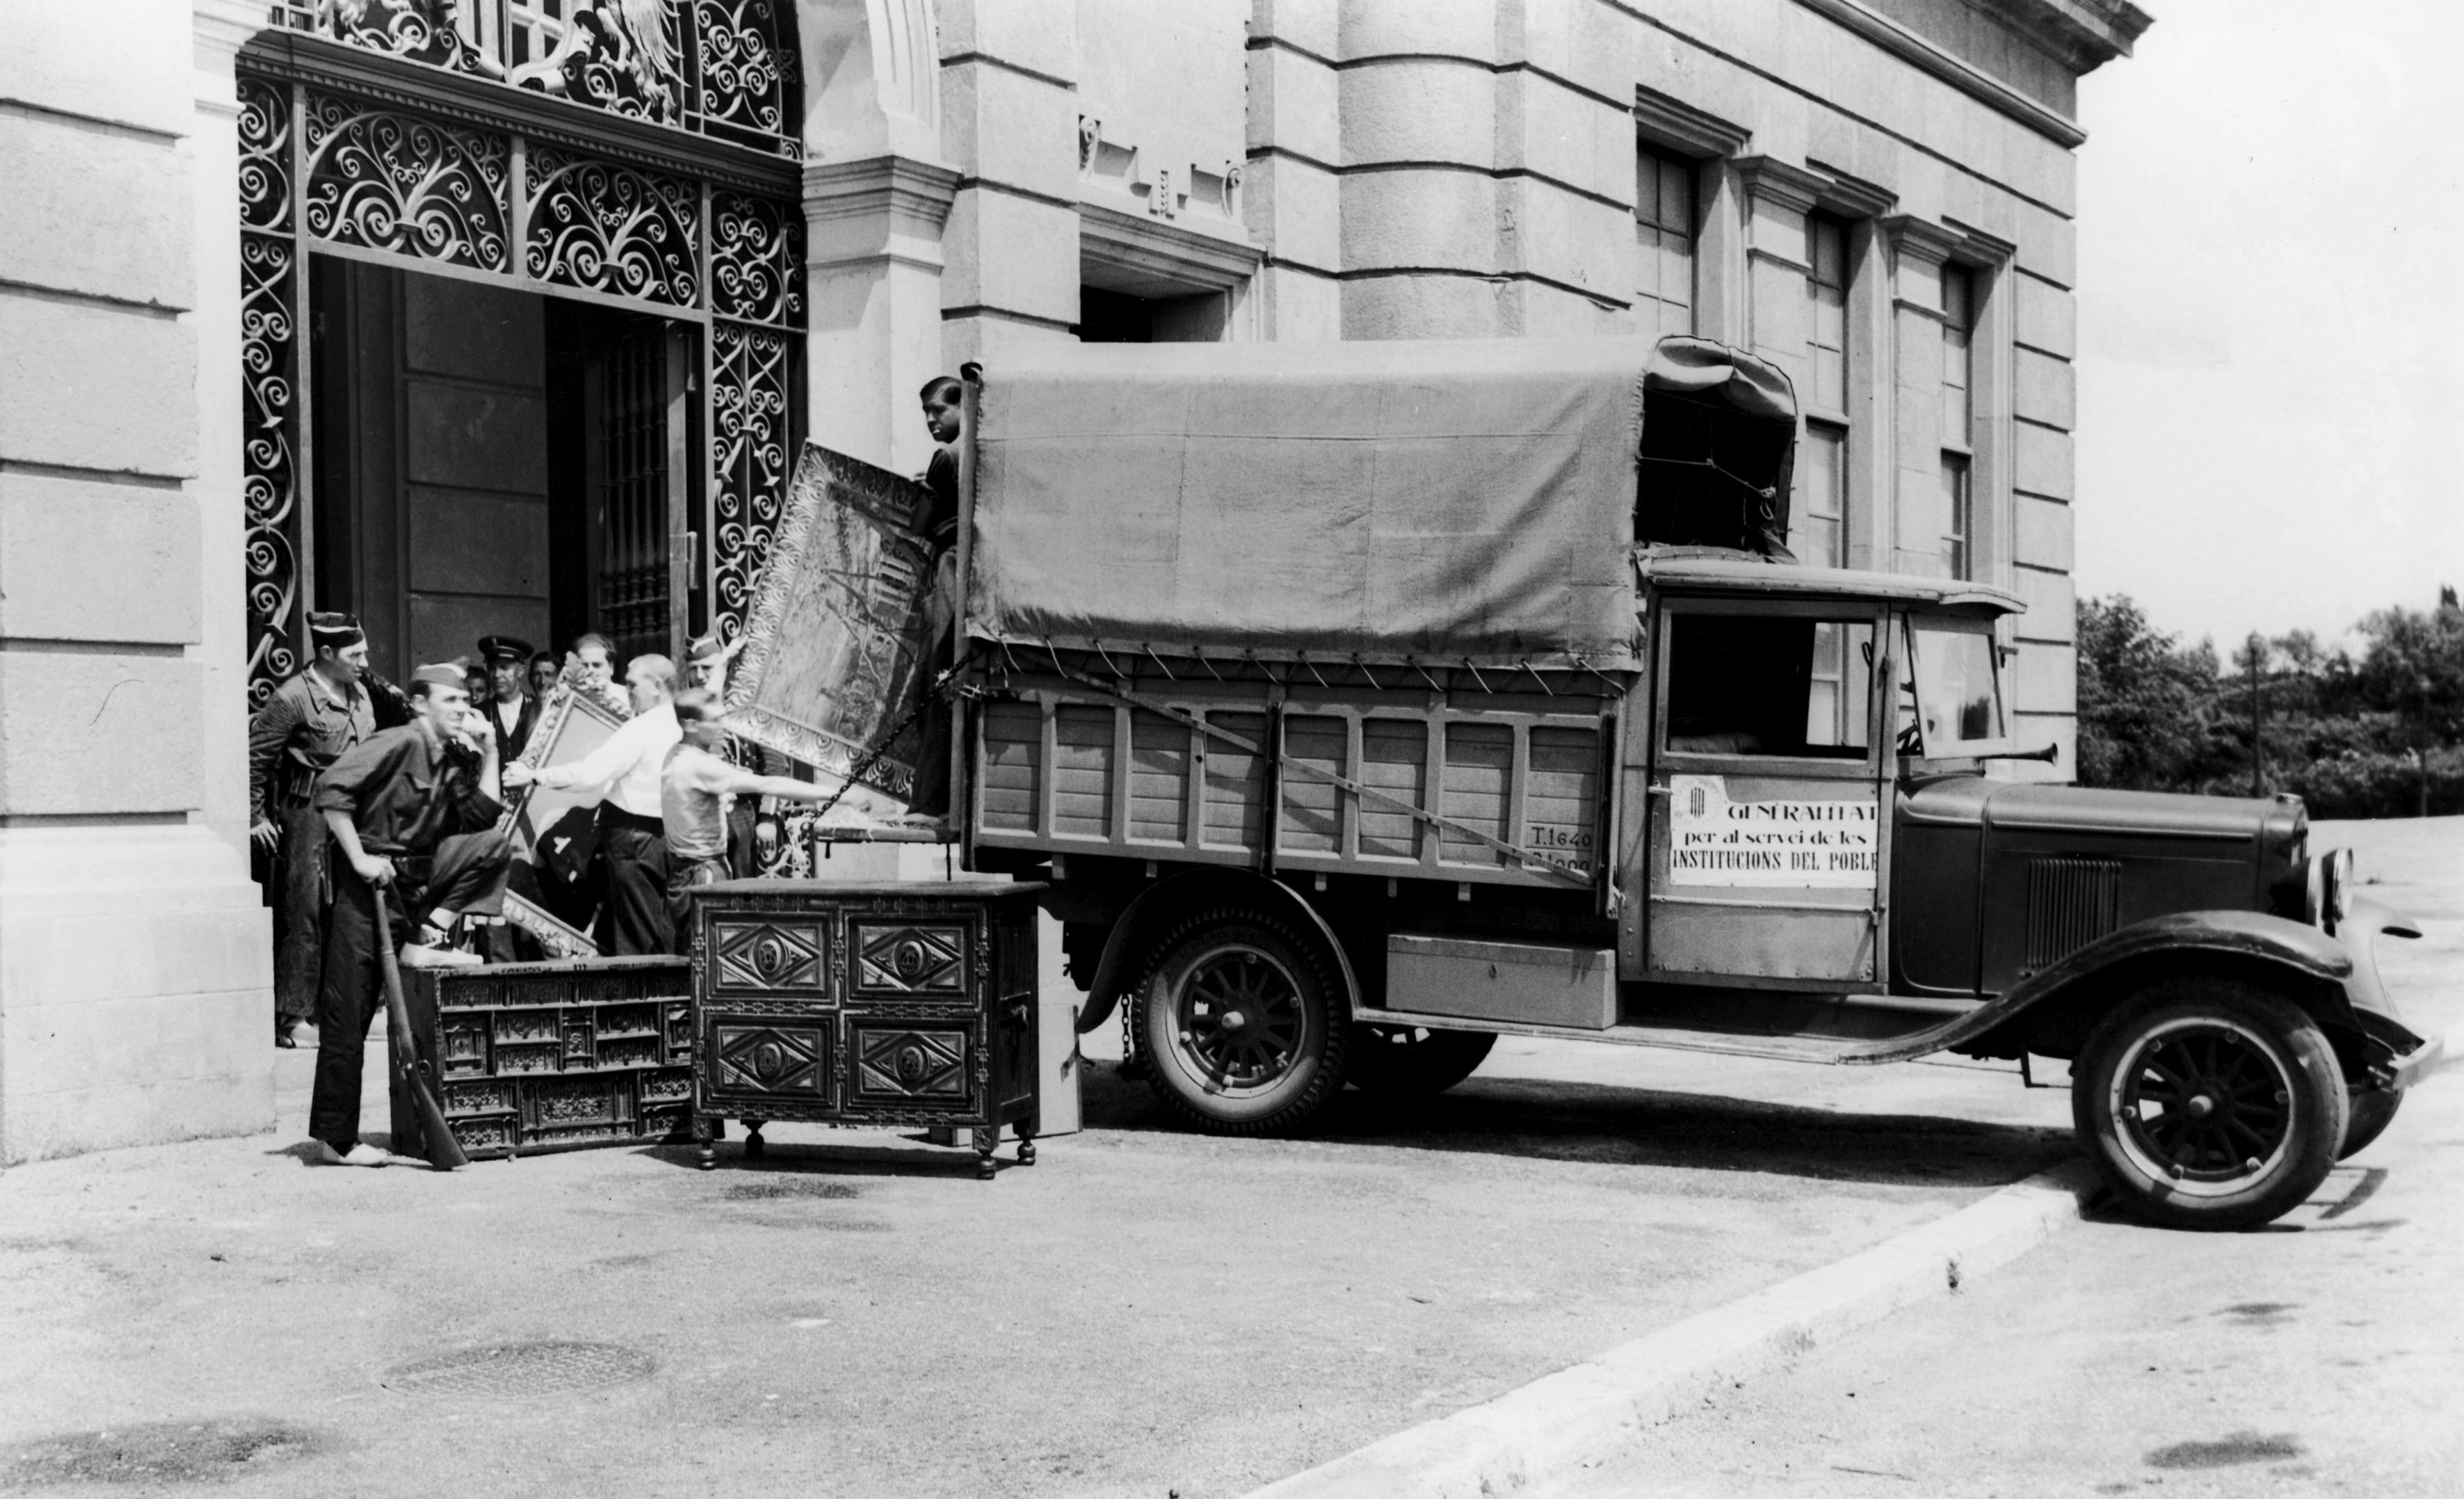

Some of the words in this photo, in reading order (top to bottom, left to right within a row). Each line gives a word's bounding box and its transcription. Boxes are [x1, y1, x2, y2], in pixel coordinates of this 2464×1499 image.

[1728, 805, 1877, 822] GENERALITAT
[1531, 826, 1592, 847] T.1640
[1685, 833, 1716, 846] per
[1723, 829, 1739, 844] al
[1746, 830, 1803, 844] servei
[1810, 830, 1834, 844] de
[1840, 831, 1867, 844] les
[1673, 850, 1781, 870] INSTITUCIONS
[1791, 851, 1820, 870] DEL
[1830, 852, 1878, 871] POBLE
